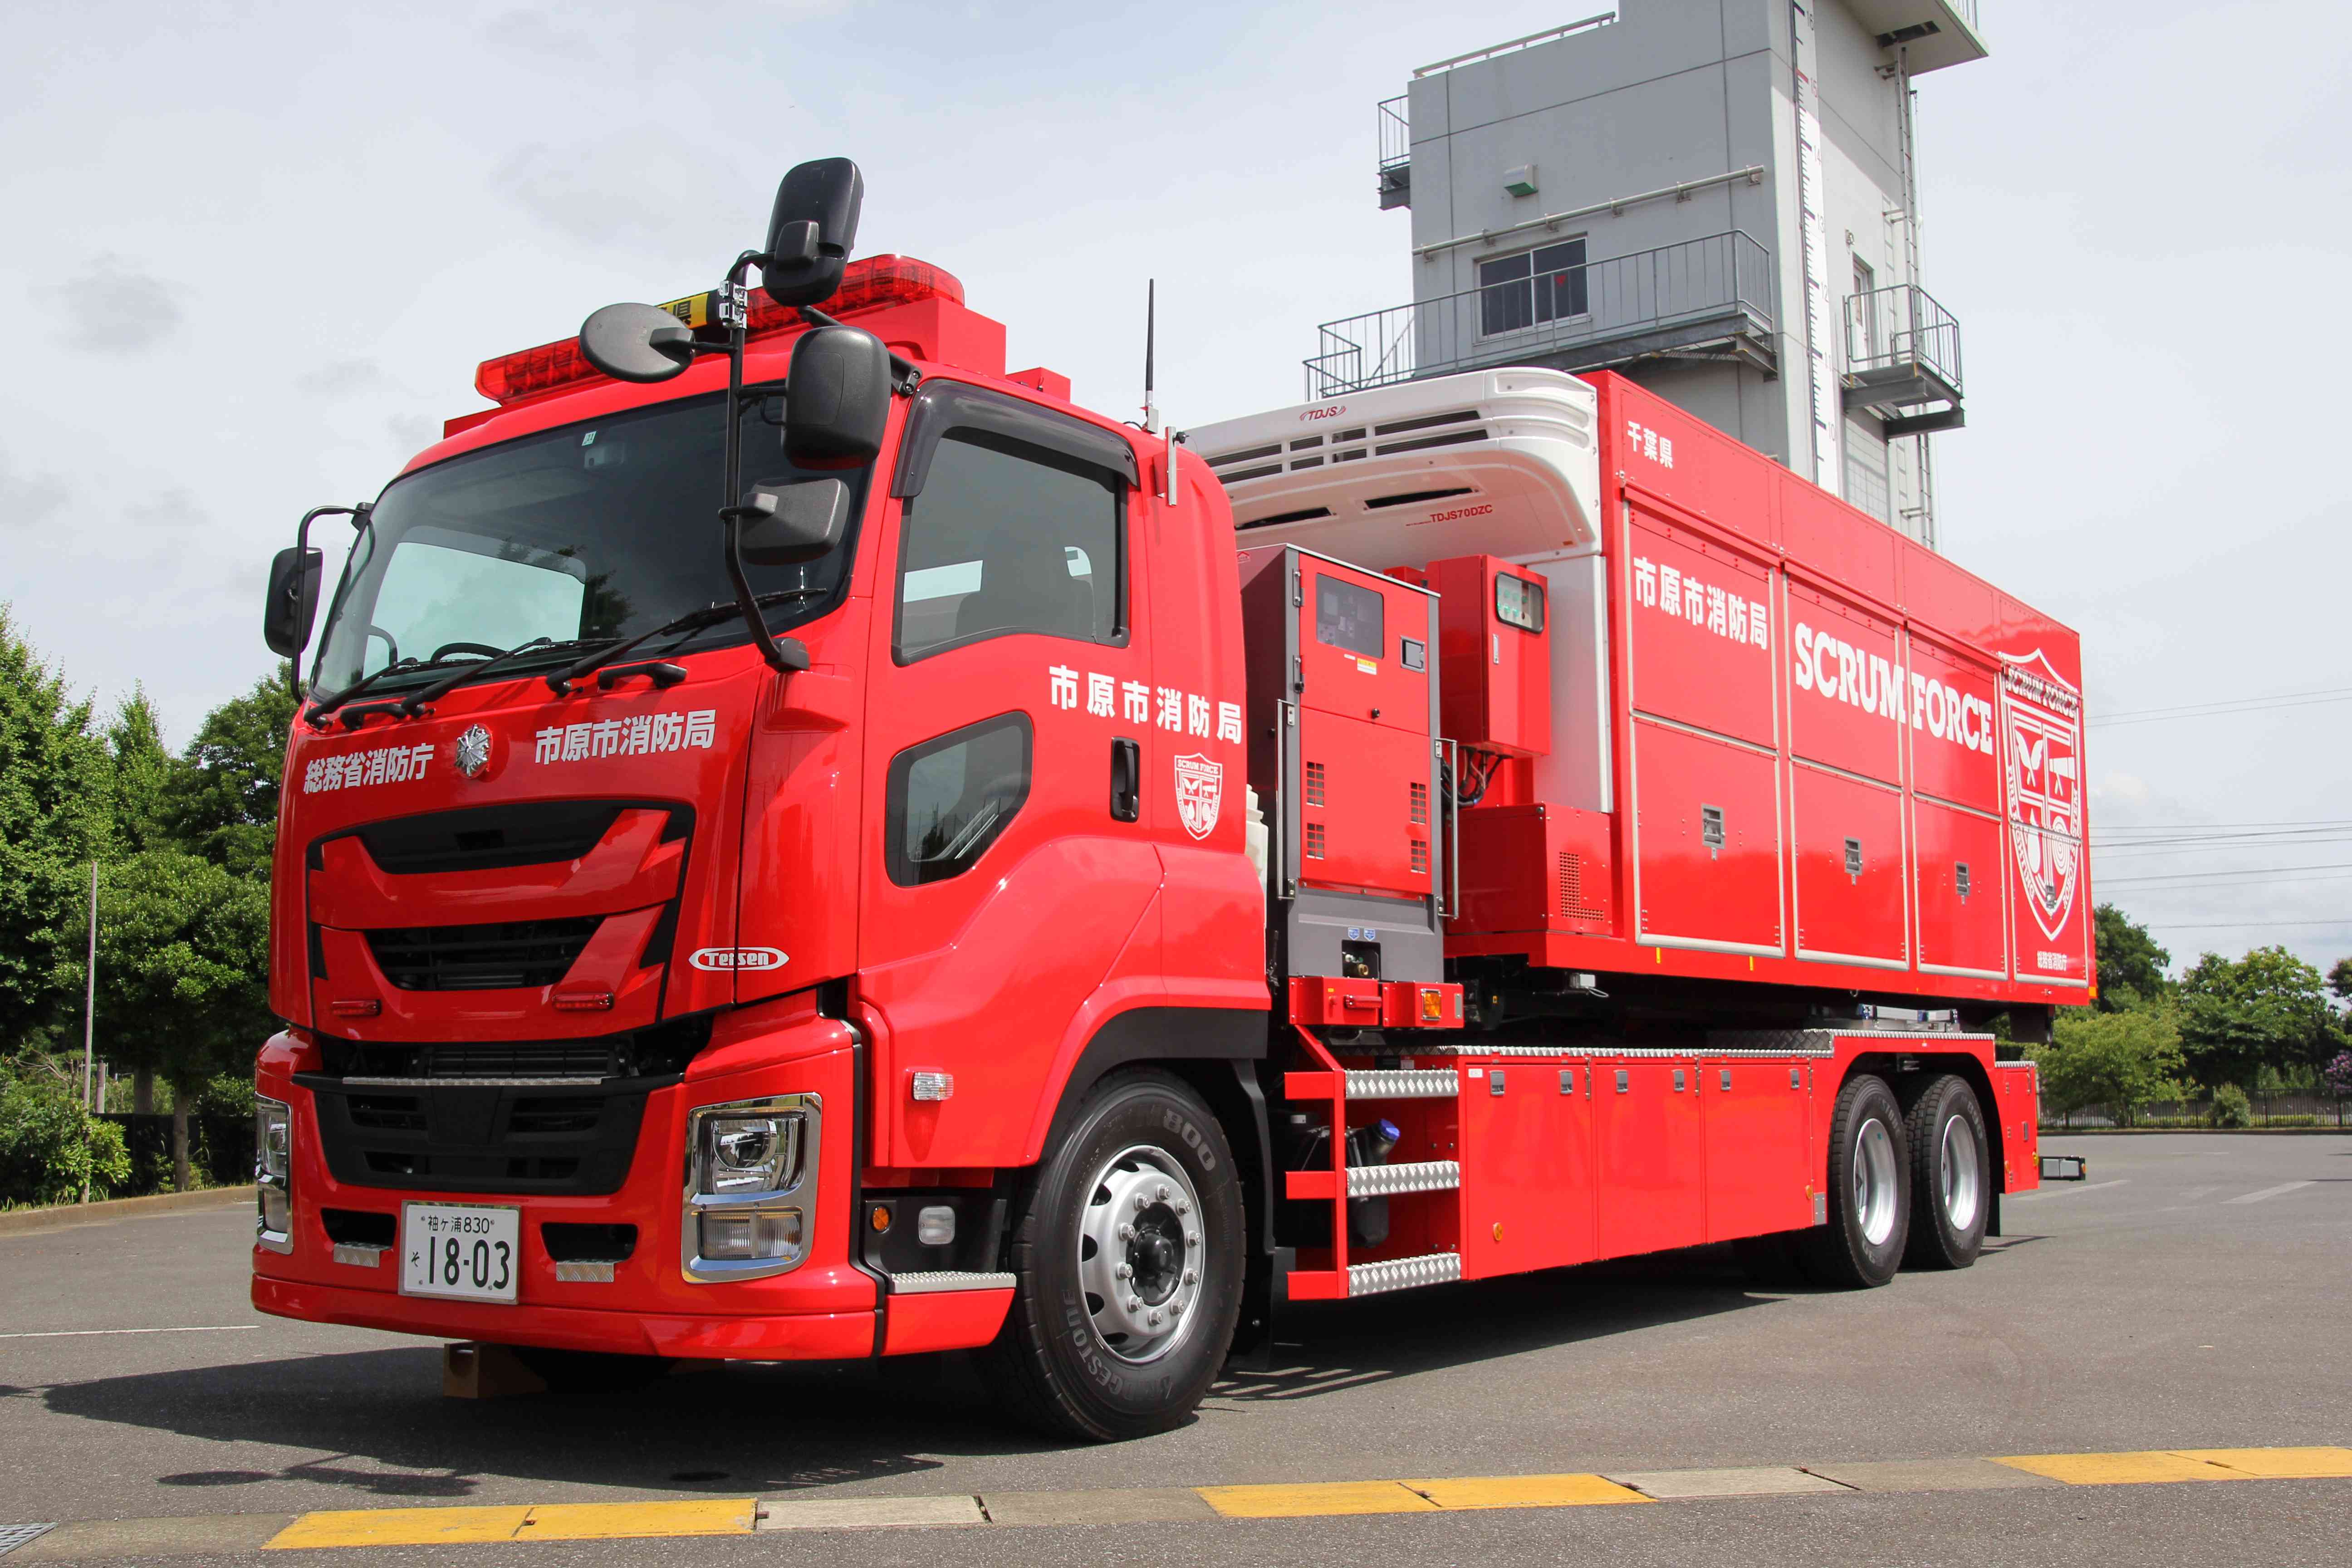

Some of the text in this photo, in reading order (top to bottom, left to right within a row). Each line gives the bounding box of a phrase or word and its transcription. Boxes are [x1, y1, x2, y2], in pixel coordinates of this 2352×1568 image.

[1807, 10, 1814, 30] 16
[1810, 78, 1818, 98] 15
[1308, 406, 1338, 421] TDJS
[1627, 421, 1673, 469] 千葉県
[1430, 504, 1493, 523] TDJS70DZC
[1633, 556, 1768, 649] 市原市消防局
[1049, 664, 1243, 744] 市原市消防局
[1794, 622, 1993, 755] SCRUM FORCE
[2006, 665, 2078, 718] SCRUM FORCE
[535, 709, 716, 765] 市原市消防局
[303, 742, 434, 794] 総務省消防庁
[1178, 759, 1219, 774] SCRUM FORCE
[411, 1251, 420, 1267] そ
